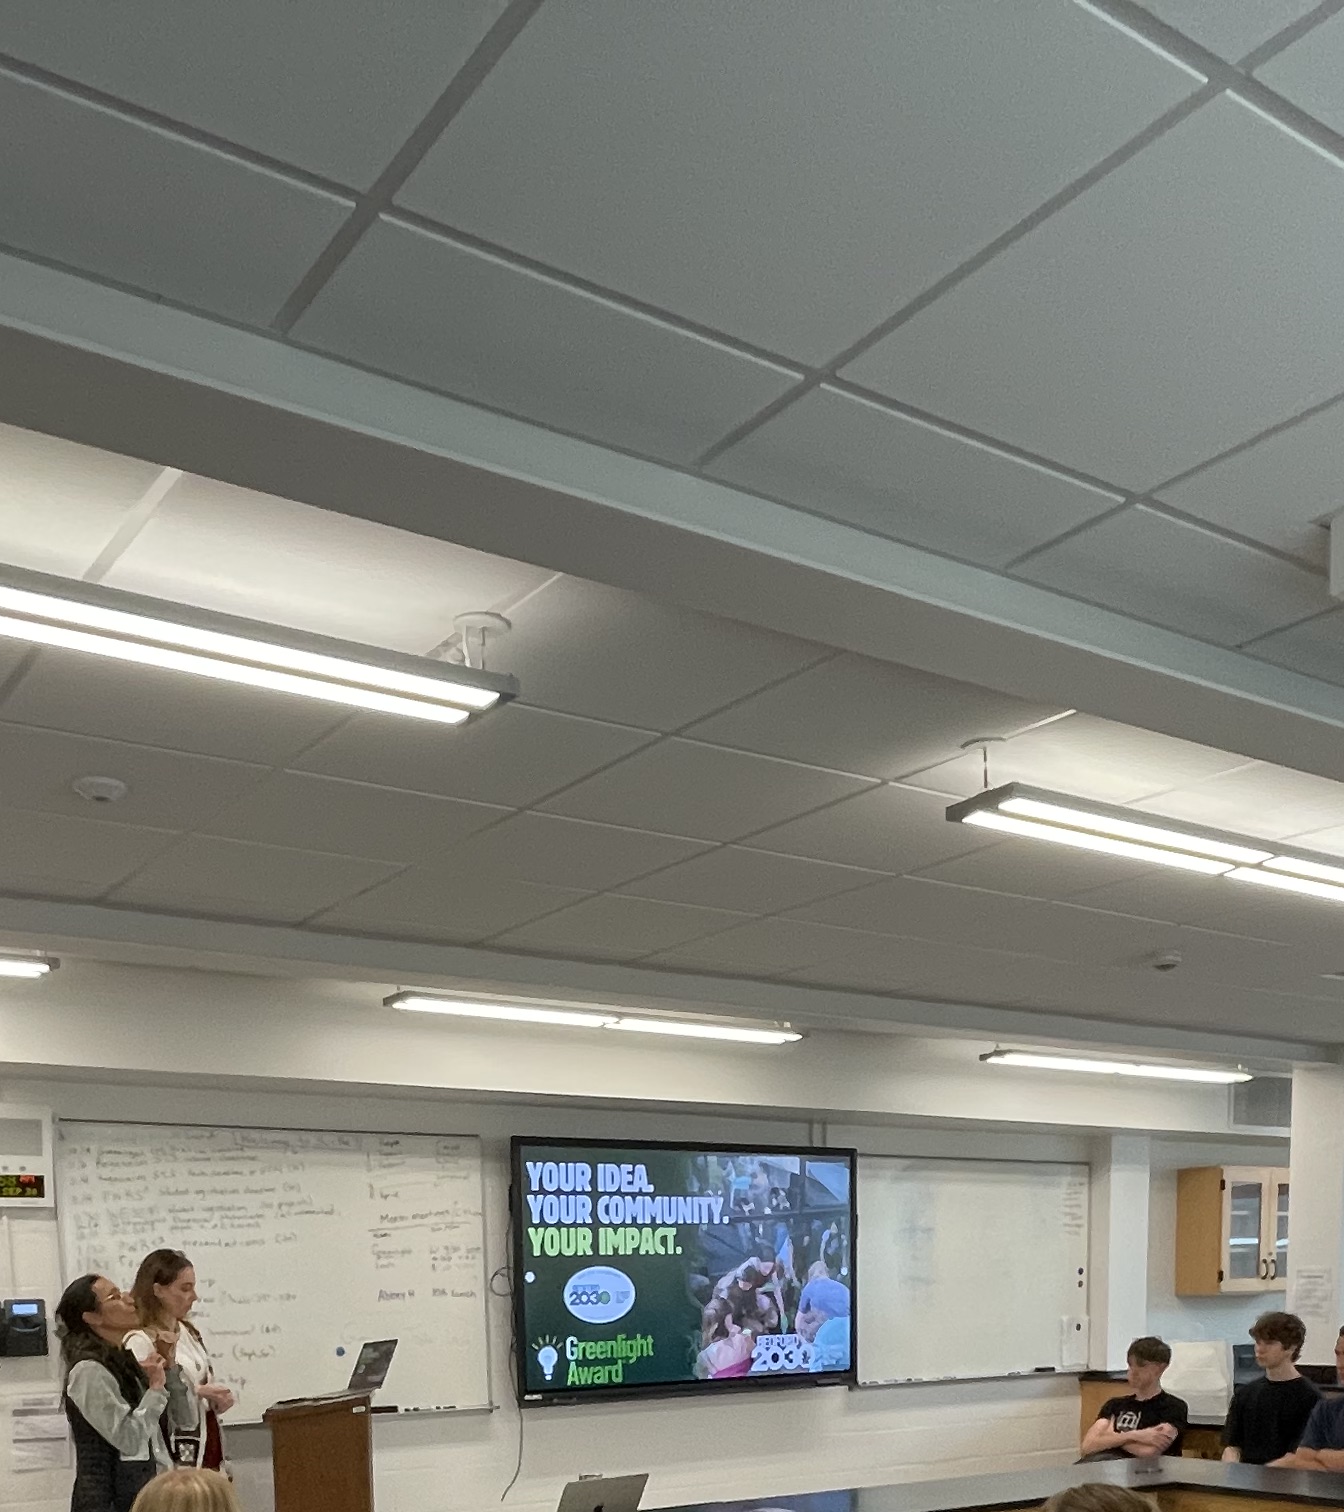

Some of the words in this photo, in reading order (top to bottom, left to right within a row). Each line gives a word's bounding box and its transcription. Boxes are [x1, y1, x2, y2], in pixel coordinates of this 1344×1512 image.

[526, 1161, 592, 1192] YOUR
[596, 1163, 655, 1193] IDEA.
[526, 1195, 593, 1224] YOUR
[596, 1195, 730, 1225] COMMUNITY.
[527, 1227, 593, 1257] YOUR
[598, 1227, 683, 1256] IMPACT.
[565, 1333, 654, 1364] Greenlight
[567, 1359, 623, 1386] Award
